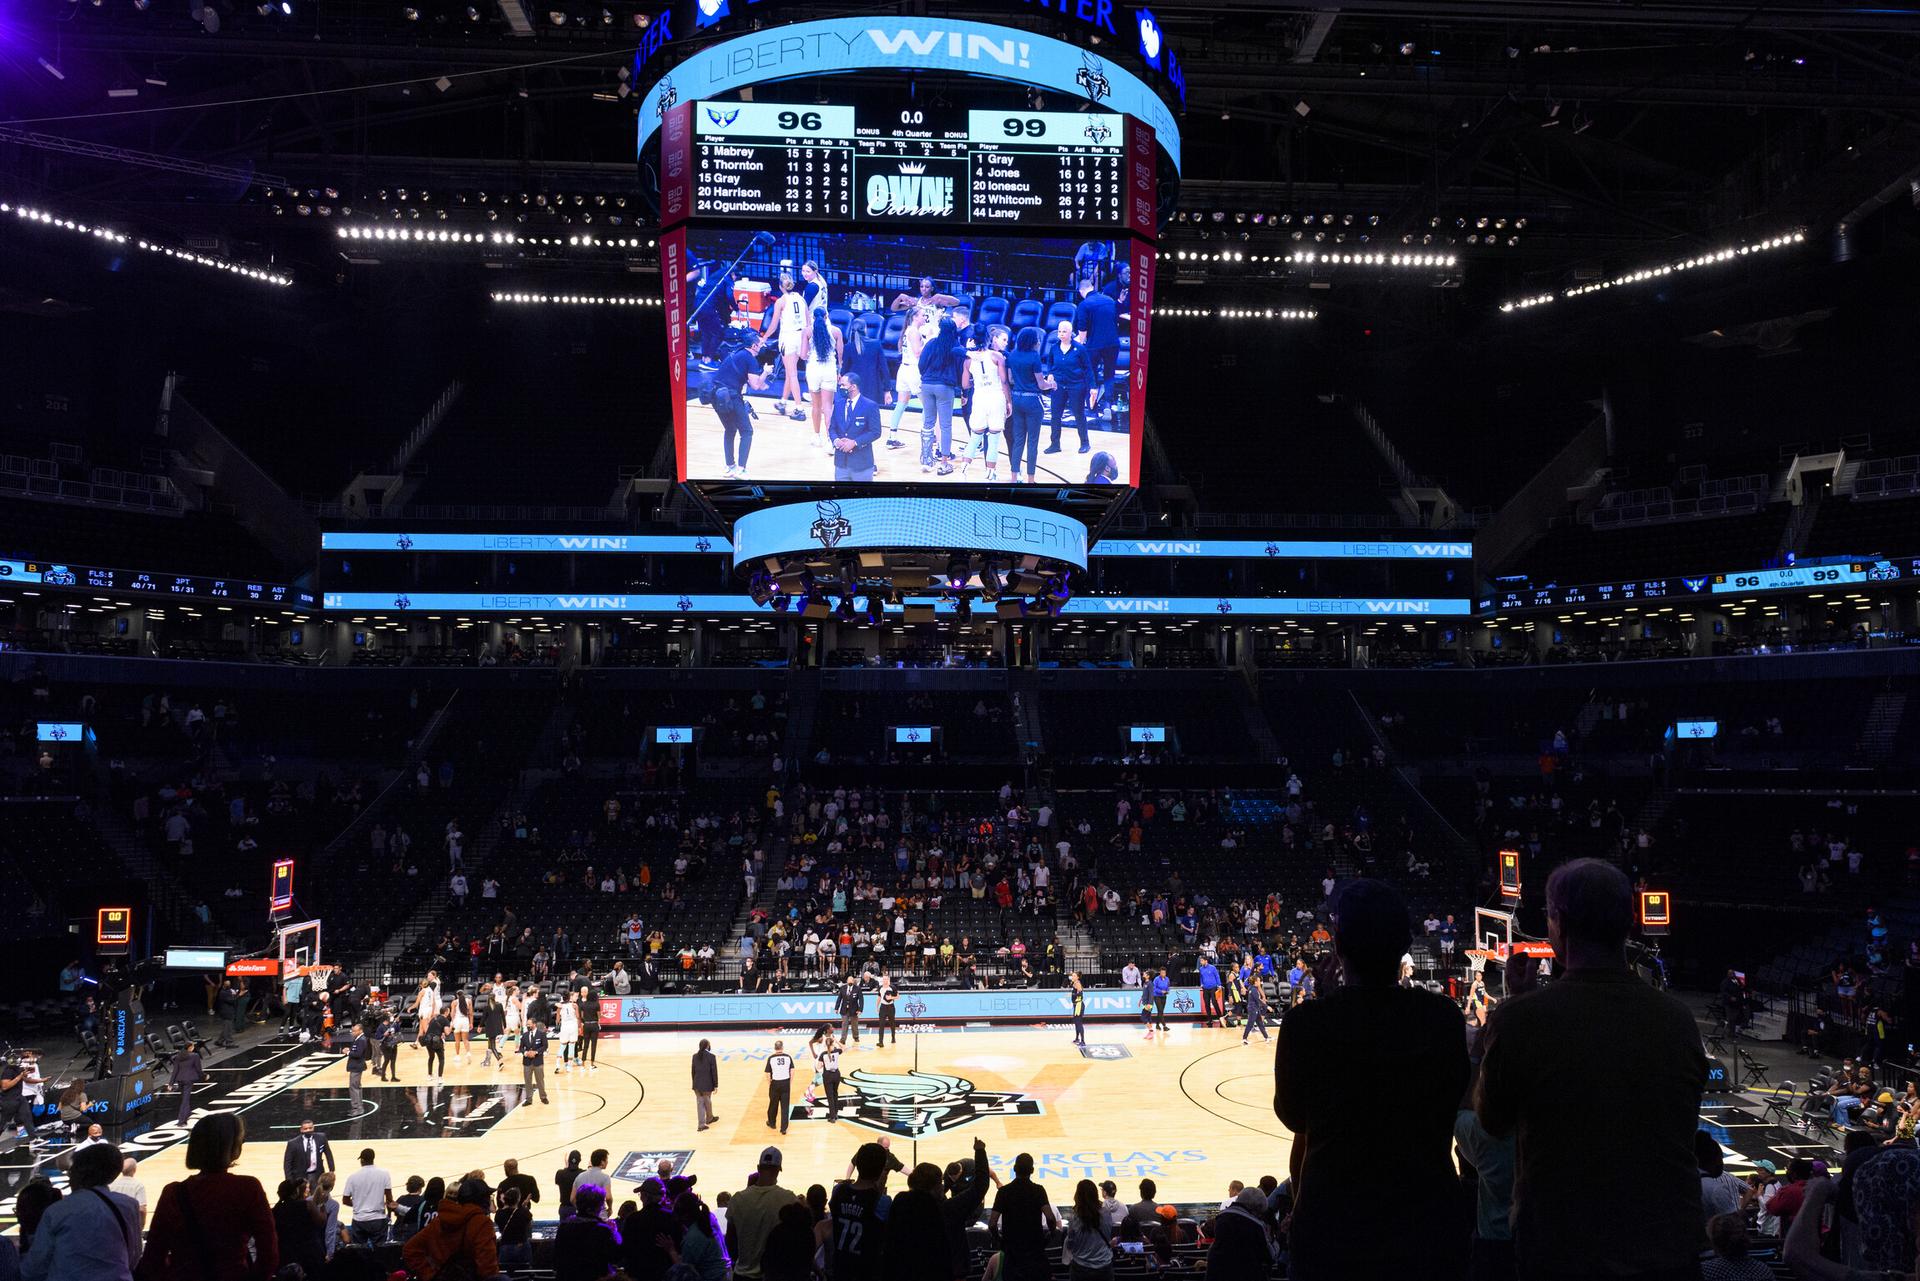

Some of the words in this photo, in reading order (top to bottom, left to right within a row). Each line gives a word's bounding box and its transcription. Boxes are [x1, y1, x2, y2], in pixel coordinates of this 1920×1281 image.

[710, 30, 864, 84] LIBERTY
[866, 30, 1030, 68] WIN!
[778, 111, 822, 131] 96
[901, 110, 923, 124] 0.0
[1003, 118, 1046, 138] 99
[702, 146, 709, 156] 3
[714, 146, 754, 158] Mabrey
[786, 149, 799, 158] 15
[806, 149, 812, 158] 5
[823, 150, 830, 158] 7
[842, 150, 848, 159] 1
[702, 160, 708, 169] 6
[714, 160, 763, 170] Thornton
[787, 162, 798, 171] 11
[806, 163, 812, 172] 3
[823, 163, 830, 172] 3
[841, 164, 848, 173] 4
[977, 154, 983, 164] 1
[988, 154, 1014, 166] Gray
[1060, 156, 1071, 166] 11
[1079, 157, 1084, 166] 1
[1094, 157, 1100, 166] 7
[1111, 158, 1118, 166] 3
[699, 173, 711, 182] 15
[714, 174, 740, 185] Gray
[786, 176, 799, 185] 10
[806, 176, 812, 185] 3
[823, 177, 830, 186] 2
[840, 177, 847, 186] 5
[976, 168, 983, 177] 4
[988, 168, 1020, 178] Jones
[1059, 170, 1072, 179] 16
[1078, 170, 1085, 179] 0
[1094, 171, 1101, 180] 2
[1111, 171, 1118, 180] 2
[698, 187, 711, 196] 20
[714, 187, 761, 198] Harrison
[786, 189, 799, 199] 23
[806, 190, 812, 199] 2
[823, 190, 830, 199] 7
[841, 191, 848, 200] 2
[866, 174, 944, 211] OWN
[944, 177, 953, 209] THE
[973, 181, 986, 190] 20
[988, 182, 1030, 191] Ionescu
[1059, 183, 1072, 192] 13
[1076, 184, 1087, 192] 12
[1095, 184, 1101, 193] 3
[1111, 184, 1118, 193] 2
[698, 200, 711, 210] 24
[713, 201, 781, 212] Ogunbowale
[786, 203, 799, 212] 12
[805, 203, 812, 212] 3
[824, 204, 830, 213] 1
[840, 204, 847, 213] 0
[973, 194, 986, 204] 32
[988, 195, 1042, 205] Whitcomb
[1059, 197, 1072, 206] 26
[1078, 197, 1085, 206] 4
[1095, 198, 1101, 206] 7
[1111, 198, 1118, 207] 0
[973, 208, 986, 217] 44
[988, 208, 1020, 220] Laney
[1060, 210, 1072, 219] 18
[1078, 210, 1085, 219] 7
[1096, 211, 1101, 220] 1
[1112, 211, 1118, 220] 3
[668, 244, 681, 353] BIOSTEEL
[1136, 254, 1148, 360] BIOSTEEL
[974, 513, 1081, 553] LIBERTY
[484, 536, 558, 549] LIBERTY
[559, 538, 627, 549] WIN!
[1136, 542, 1200, 554] WIN!
[1344, 544, 1412, 555] LIBERTY
[28, 564, 37, 572] B
[1780, 570, 1793, 578] 0.0
[1813, 569, 1839, 581] 99
[1736, 576, 1760, 588] 96
[482, 597, 556, 608] LIBERTY
[557, 597, 626, 608] WIN!
[1104, 600, 1169, 611] WIN!
[1296, 601, 1365, 612] LIBERTY
[1366, 601, 1430, 612] WIN!
[699, 1002, 782, 1016] LIBERTY
[979, 997, 1060, 1010] LIBERTY
[118, 1010, 126, 1046] BARCLAYS
[208, 1052, 350, 1104] LIBERTY
[48, 1100, 109, 1115] BAAYS
[126, 1093, 152, 1112] BARCLAYS
[838, 1218, 863, 1254] 72
